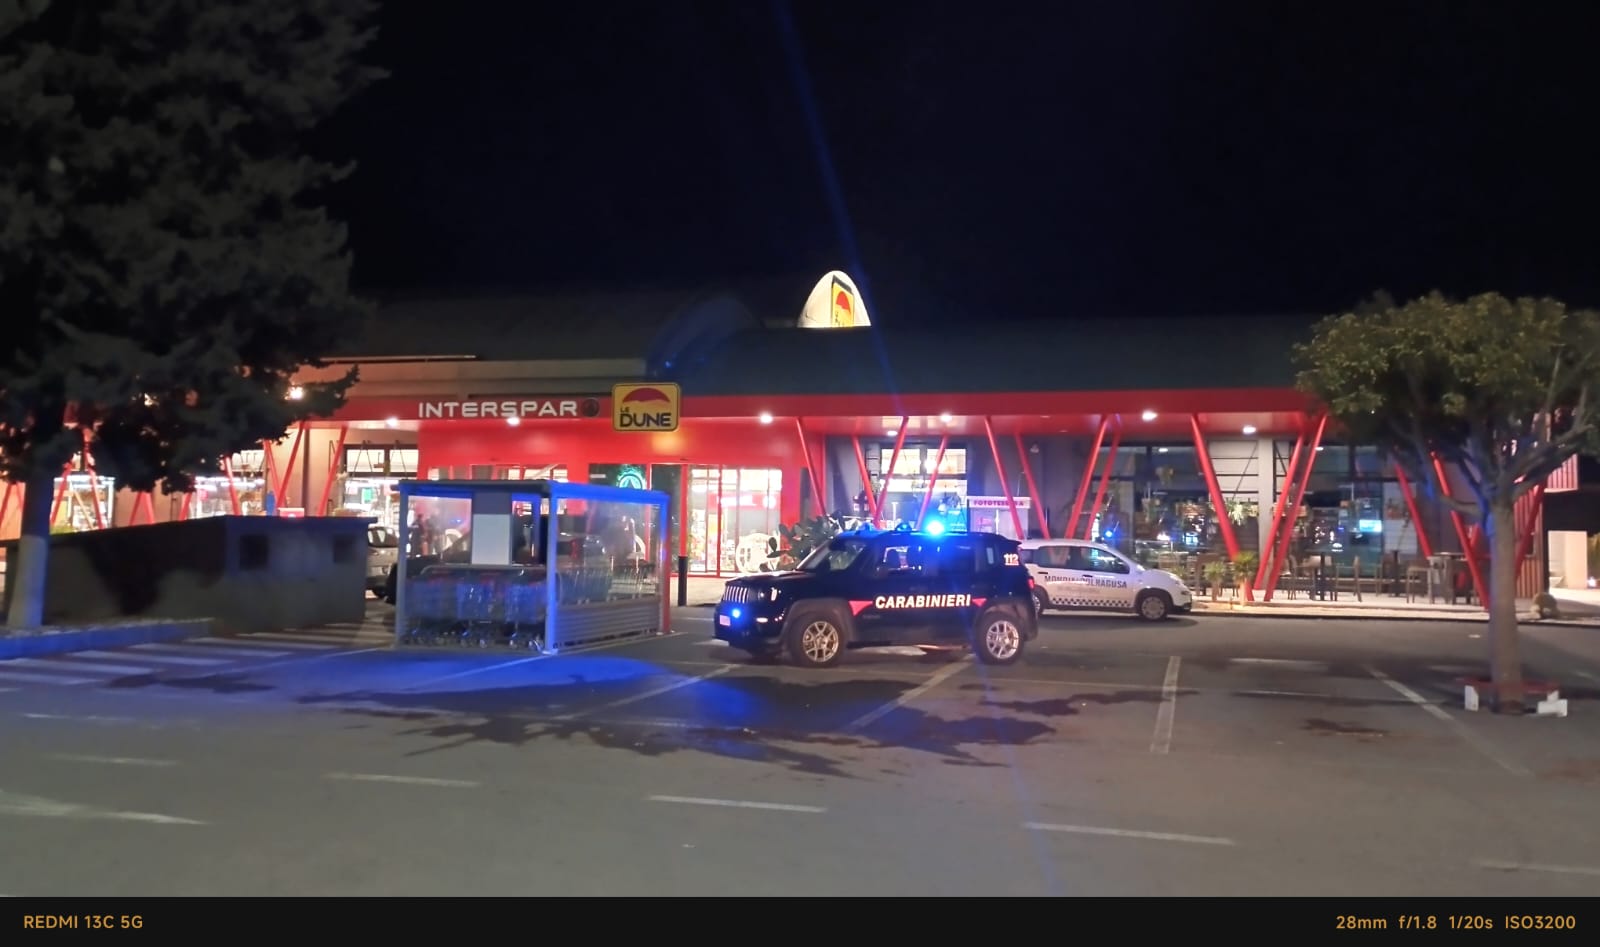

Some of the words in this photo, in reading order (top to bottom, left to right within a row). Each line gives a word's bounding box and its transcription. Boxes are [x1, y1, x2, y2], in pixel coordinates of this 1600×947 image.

[418, 400, 578, 419] INTERSPAR
[620, 412, 672, 427] DUNE
[1003, 553, 1019, 565] 112
[875, 594, 971, 609] CARABINIERI
